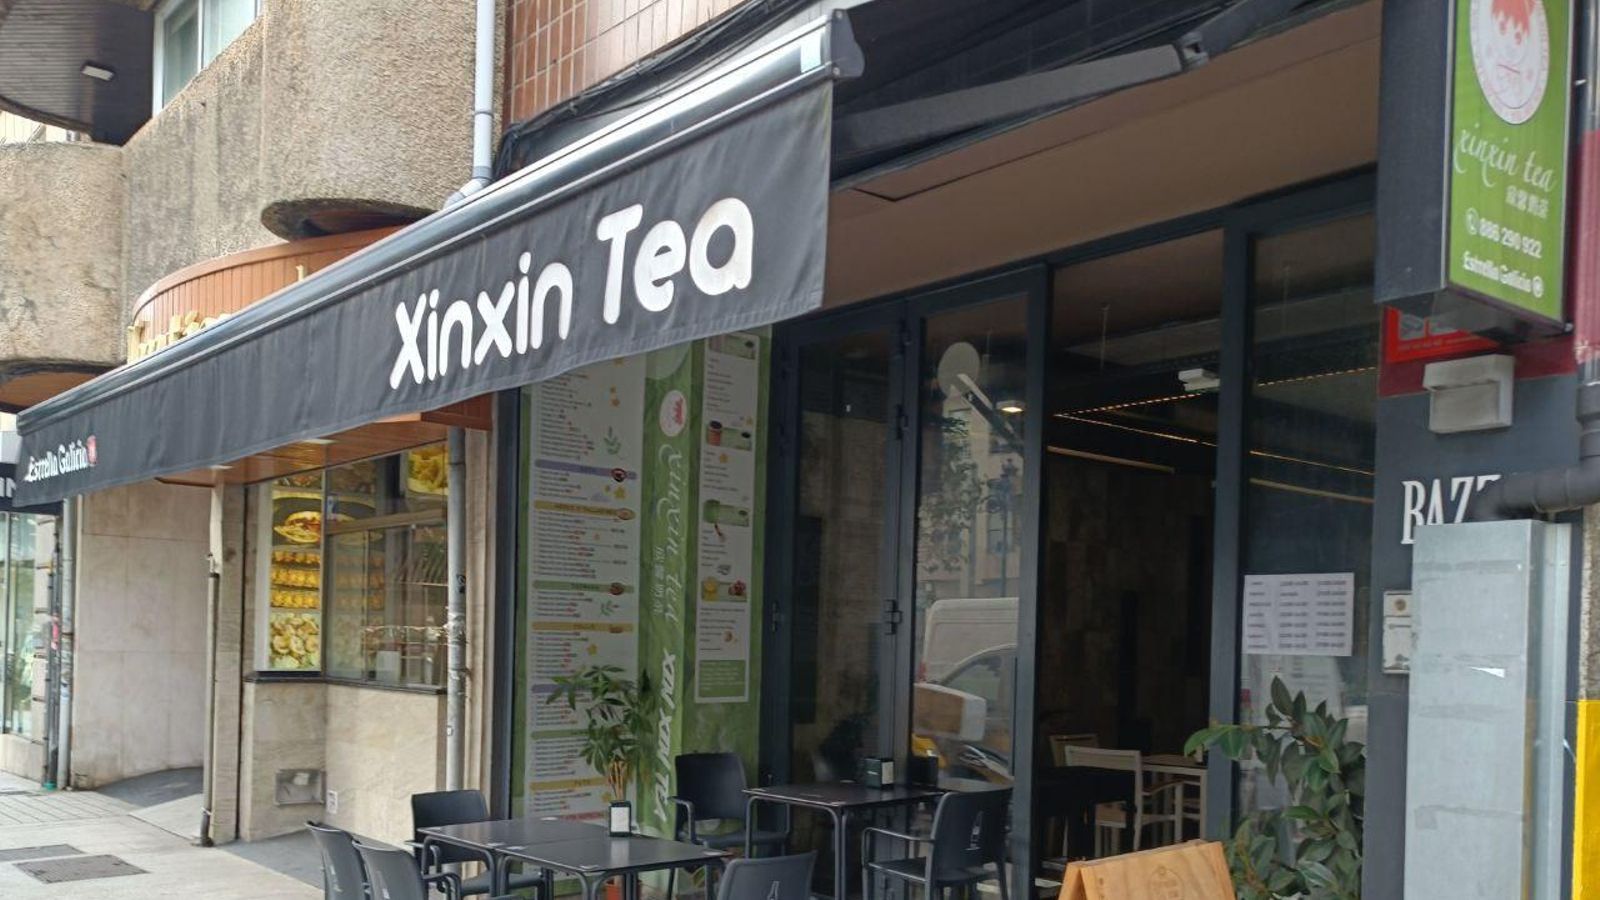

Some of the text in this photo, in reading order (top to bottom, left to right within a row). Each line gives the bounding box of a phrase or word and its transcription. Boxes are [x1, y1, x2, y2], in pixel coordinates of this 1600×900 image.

[1523, 150, 1556, 192] tea
[389, 251, 574, 391] Xinxin
[596, 197, 755, 325] Tea
